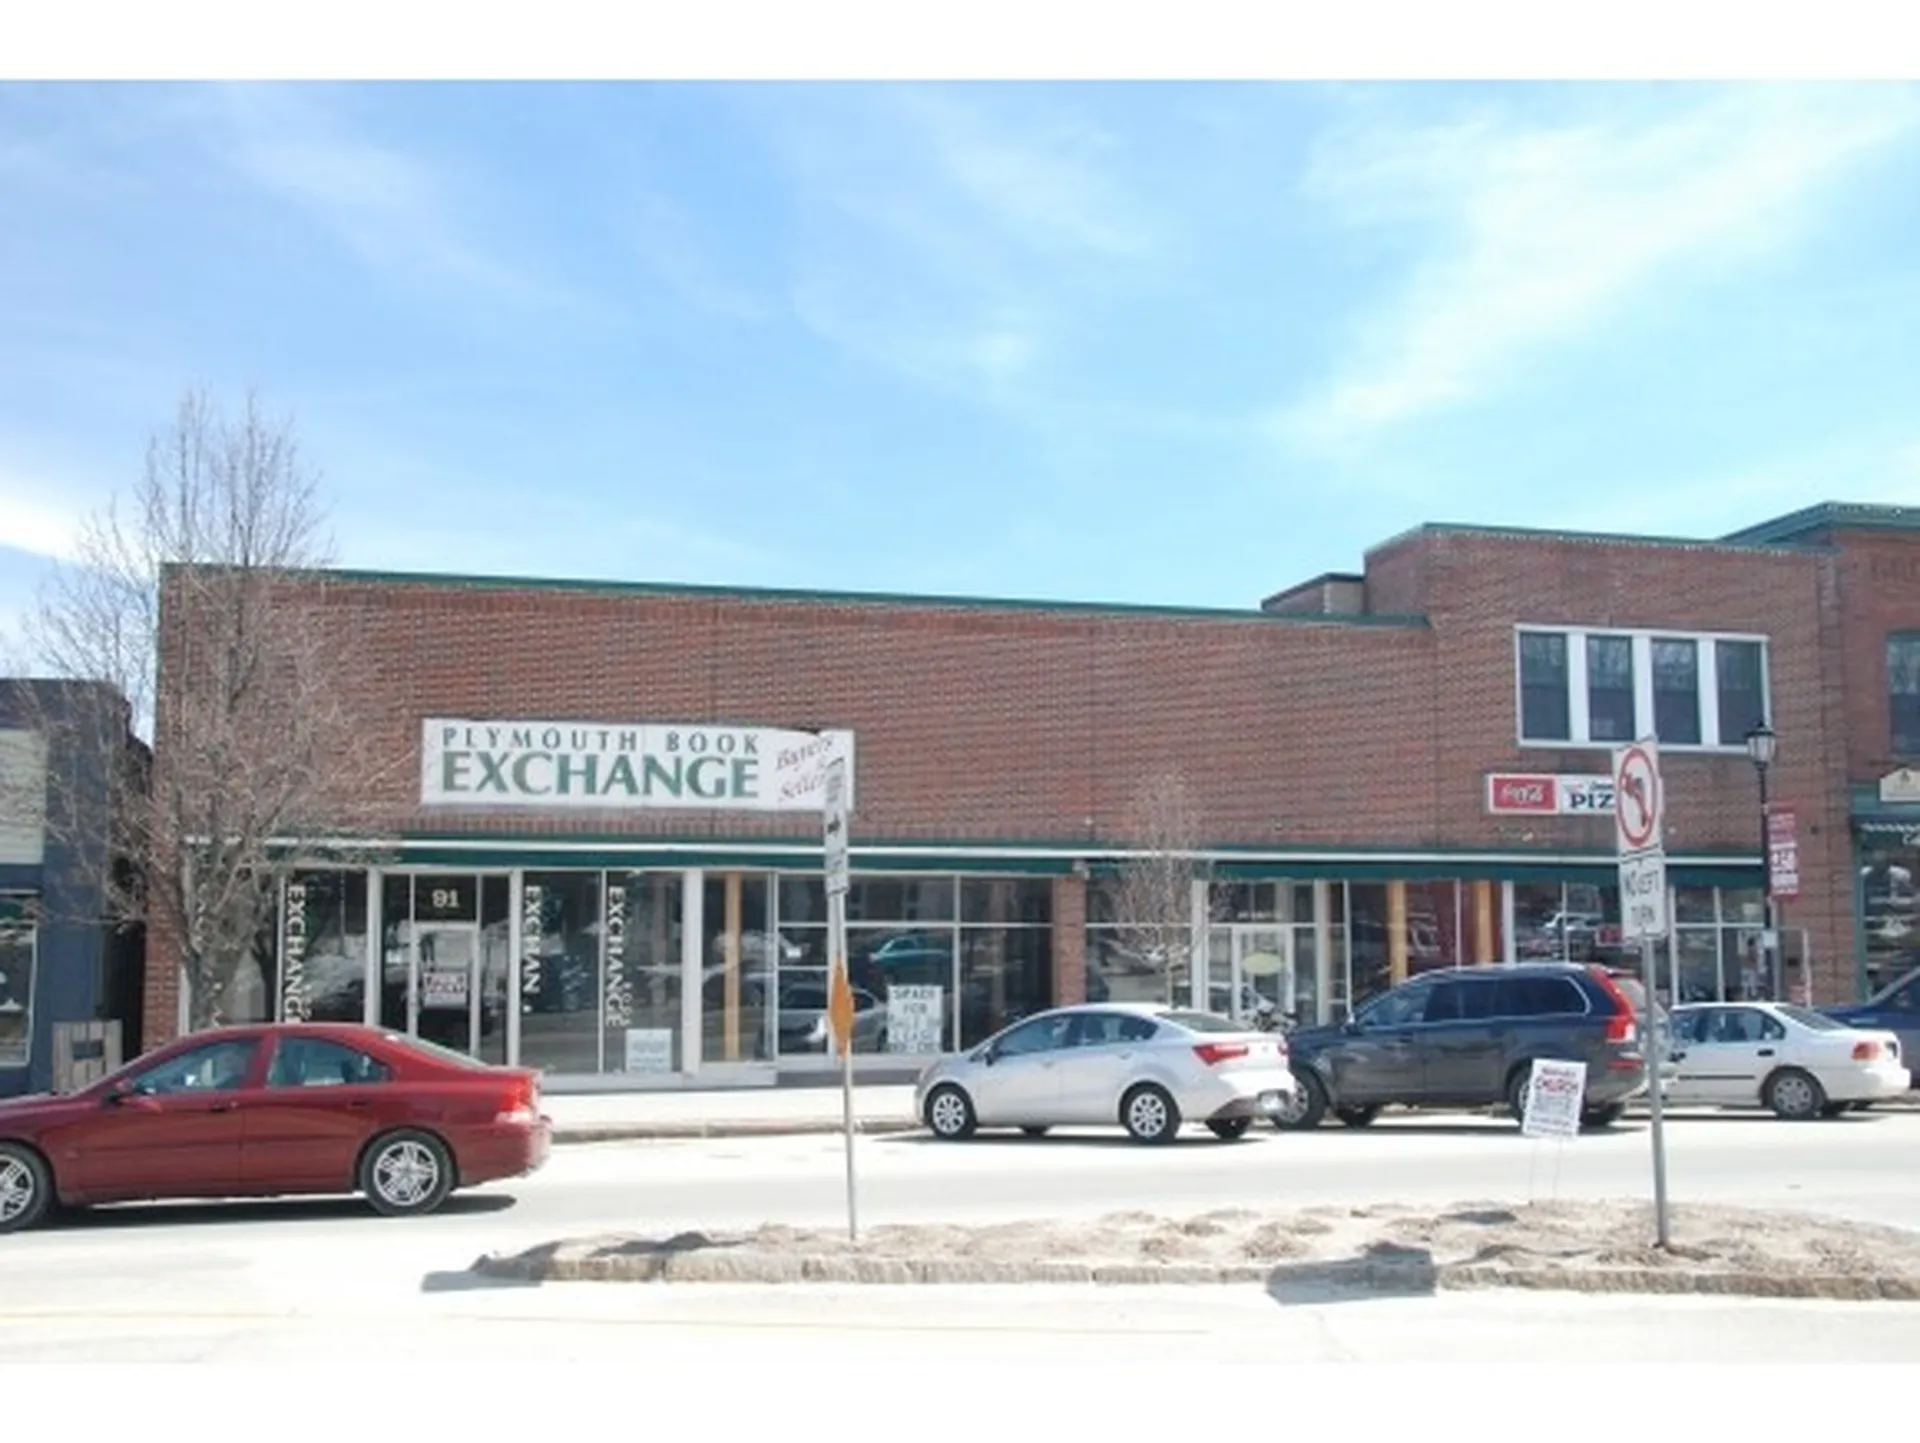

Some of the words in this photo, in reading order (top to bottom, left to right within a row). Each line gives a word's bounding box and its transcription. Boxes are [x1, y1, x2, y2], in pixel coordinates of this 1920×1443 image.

[443, 727, 637, 751] PLYMOUTH
[666, 732, 759, 755] BOOK
[443, 751, 759, 798] EXCHANGE
[1570, 793, 1616, 809] PIZ
[605, 886, 626, 1026] EXCHANGE
